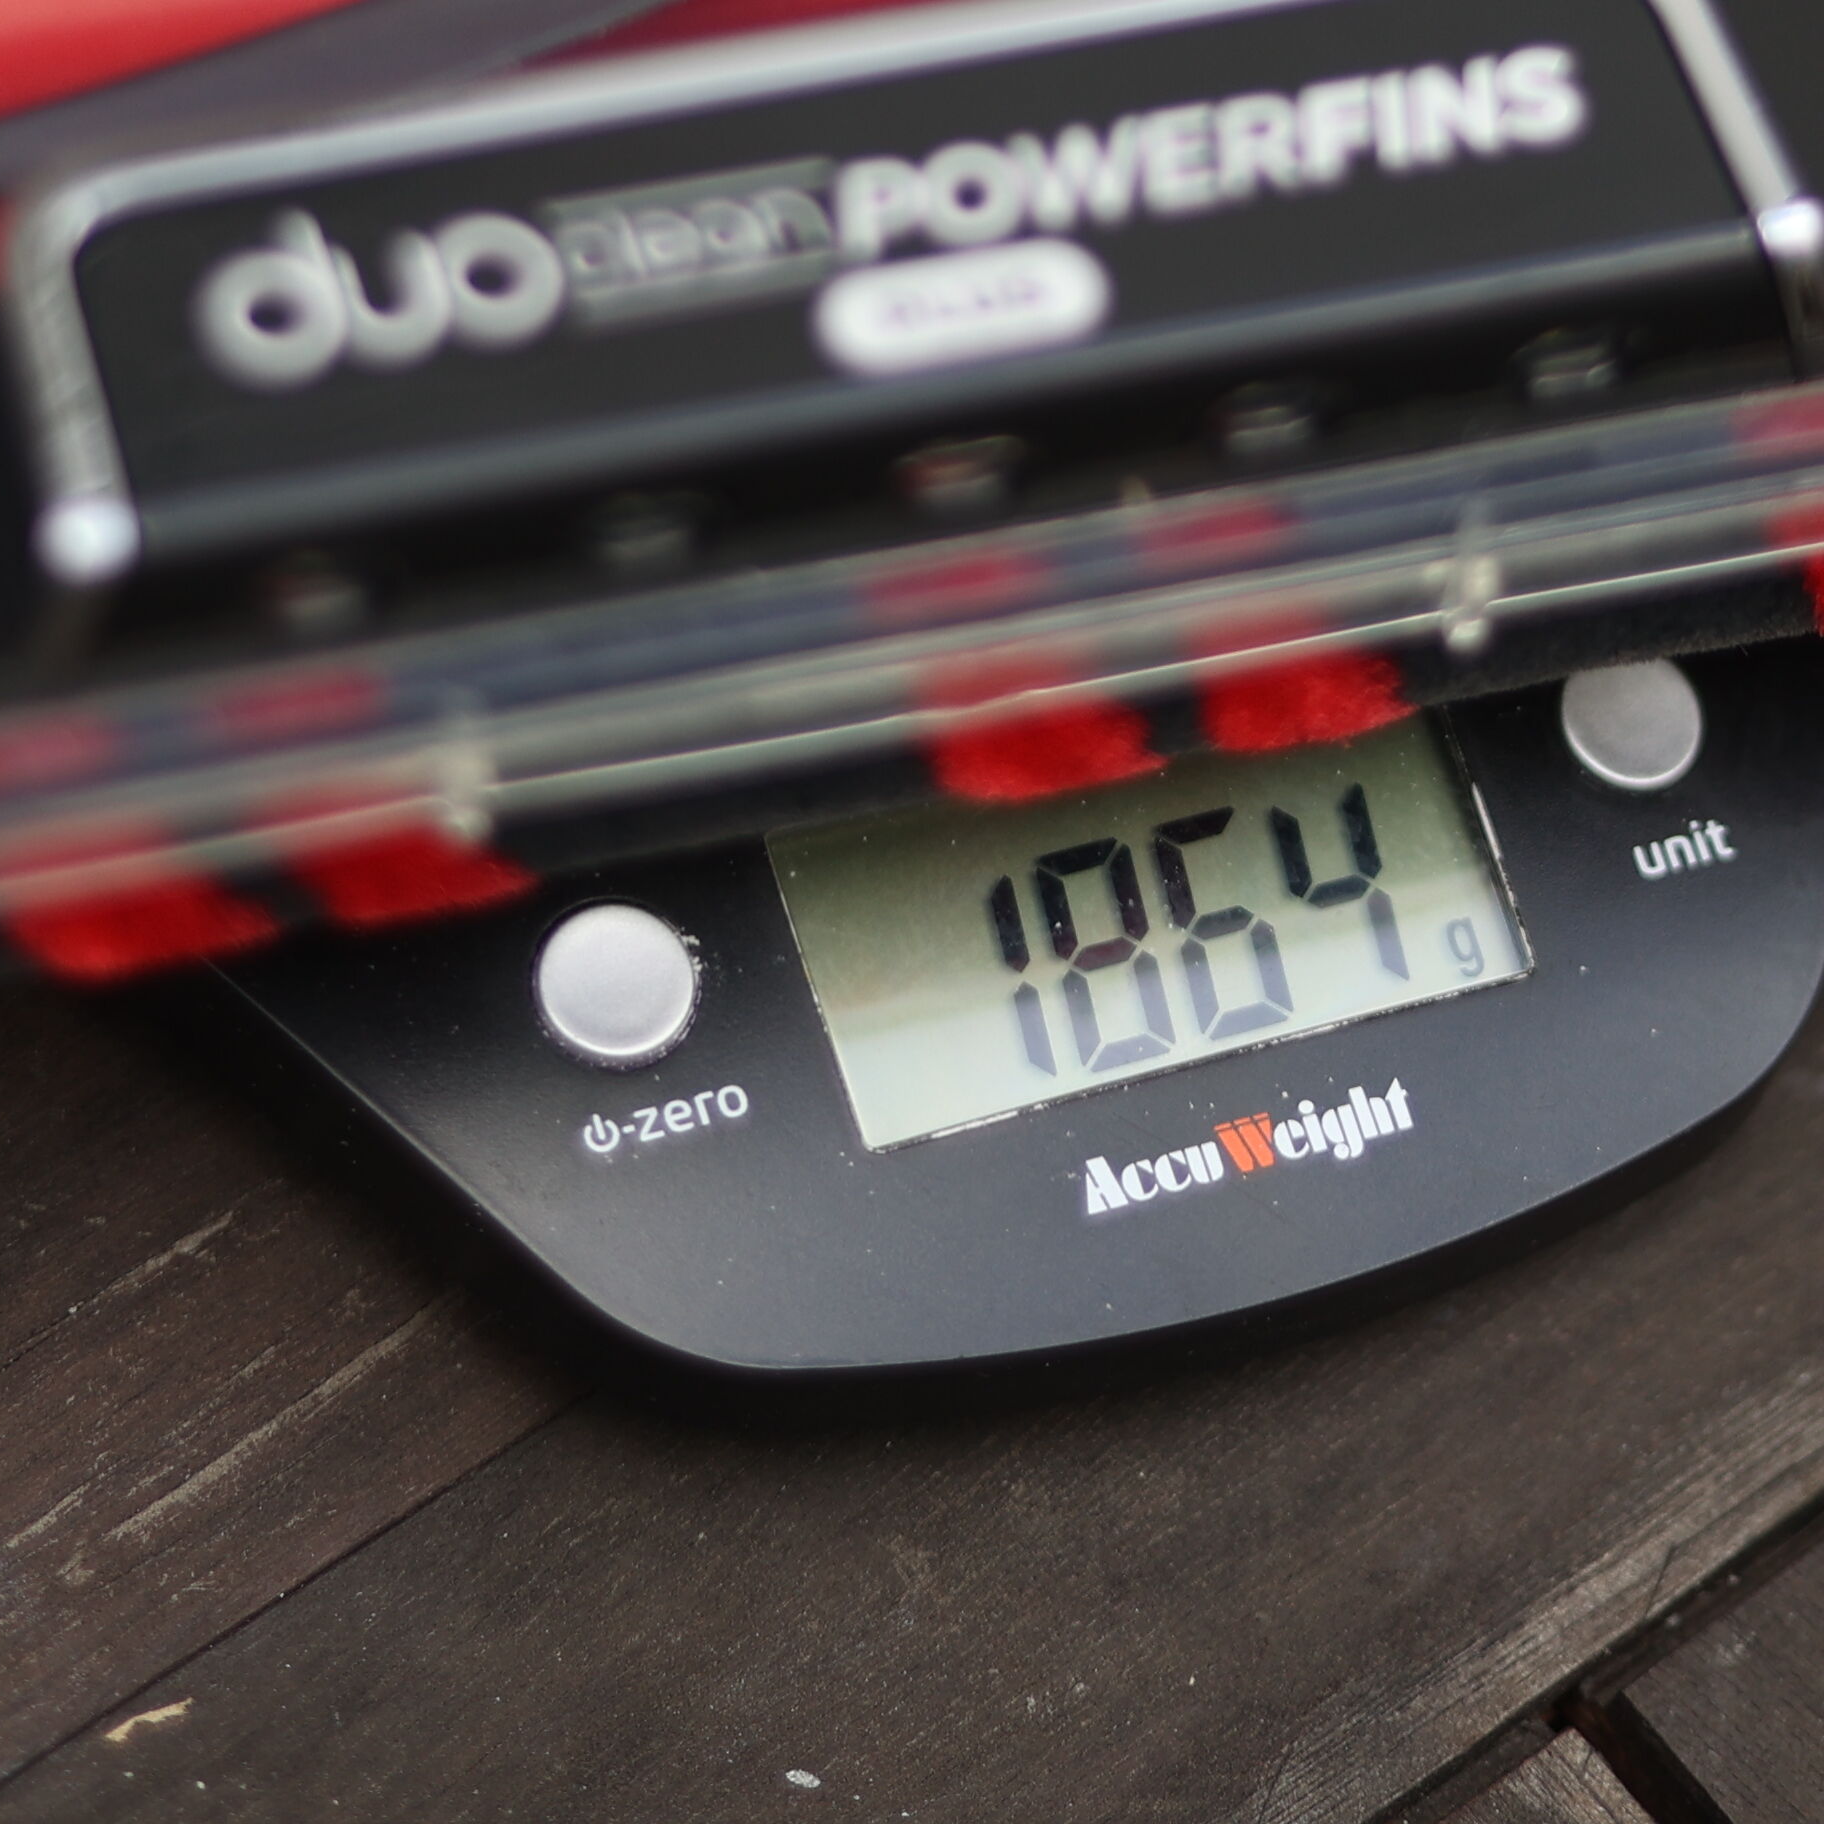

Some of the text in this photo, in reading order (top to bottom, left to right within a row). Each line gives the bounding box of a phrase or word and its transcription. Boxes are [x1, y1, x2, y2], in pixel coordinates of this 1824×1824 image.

[836, 44, 1587, 260] POWERFINS
[989, 782, 1485, 1078] 1864 g
[1633, 819, 1734, 878] unit
[1085, 1077, 1414, 1215] AccuWeight
